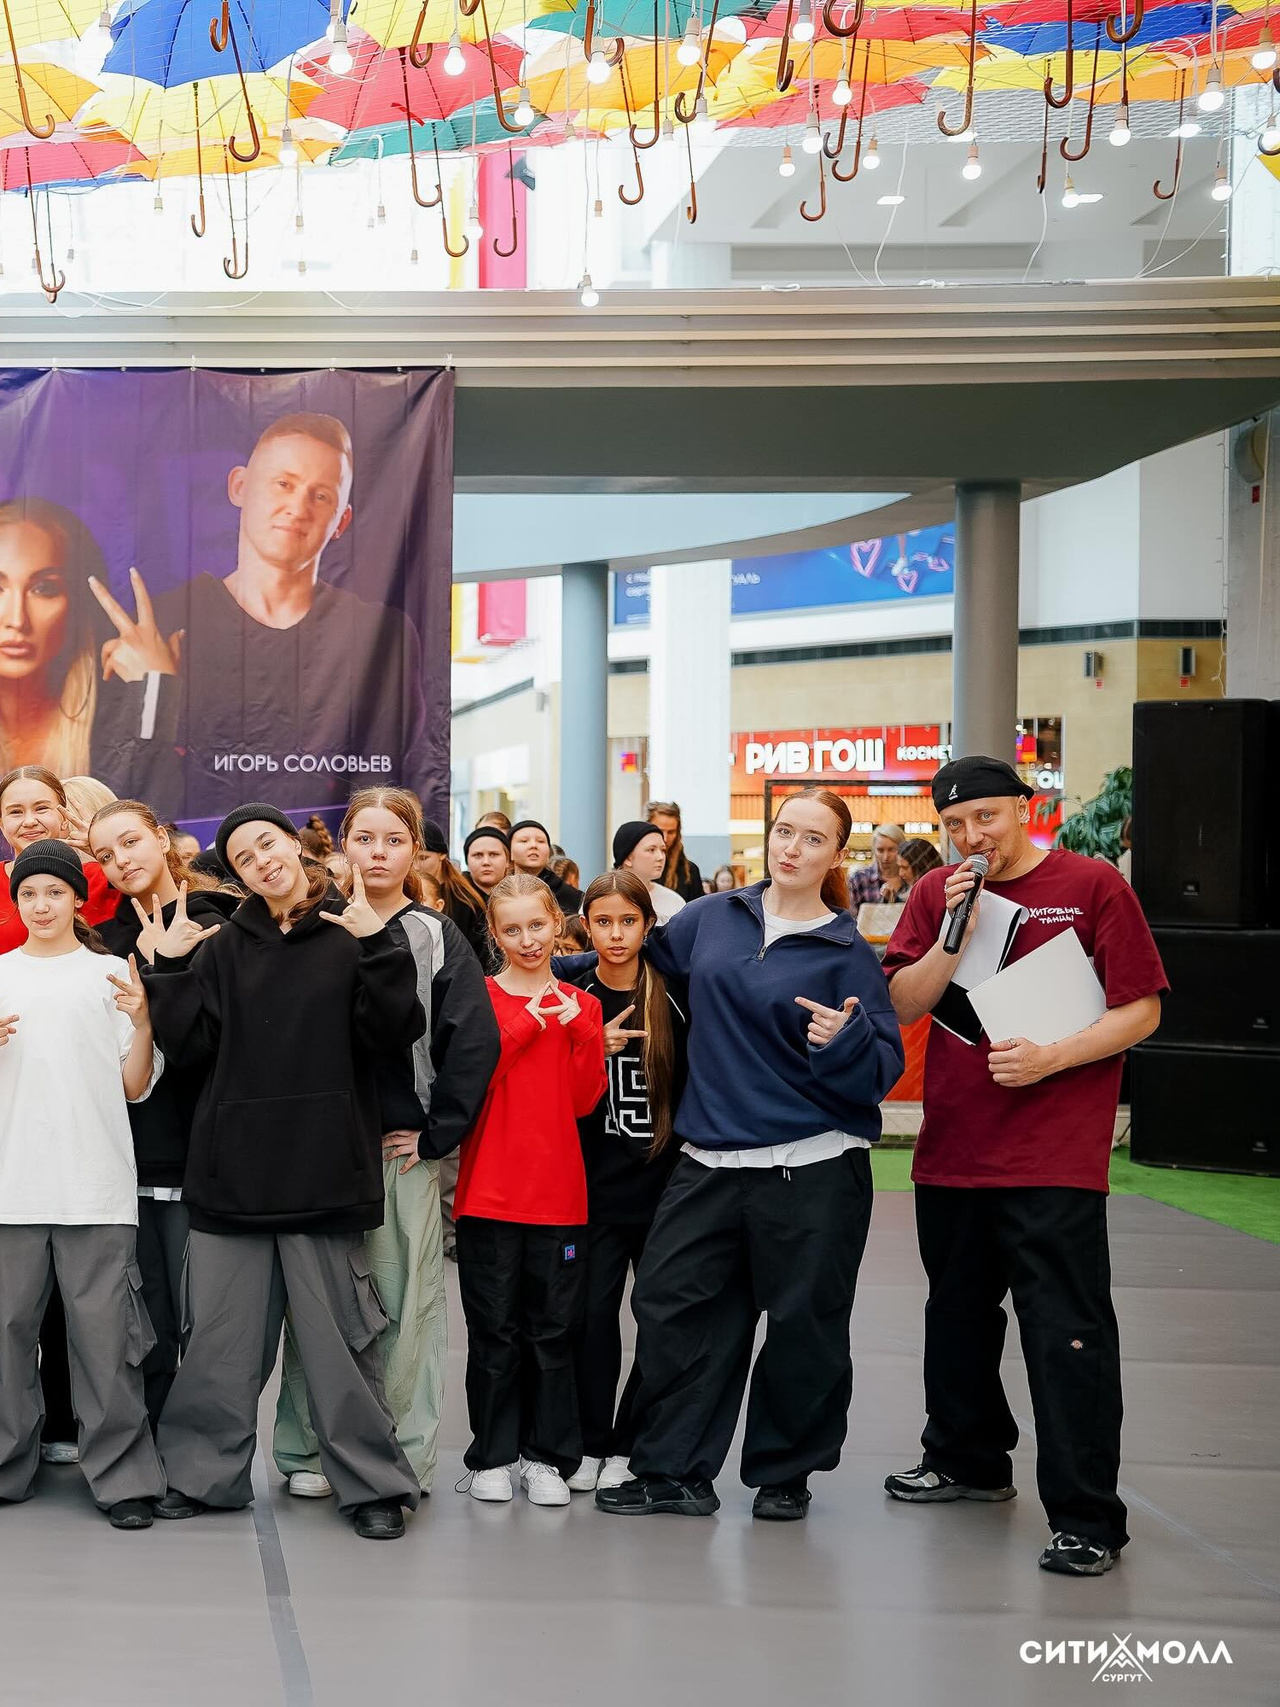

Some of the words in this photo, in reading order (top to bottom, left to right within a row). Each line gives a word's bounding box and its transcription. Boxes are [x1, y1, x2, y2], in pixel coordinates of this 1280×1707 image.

[213, 753, 279, 773] ИГОРЬ
[282, 753, 393, 773] СОЛОВЬЕВ
[745, 741, 811, 775] РИВ
[813, 737, 885, 774] ГОШ
[1029, 906, 1085, 919] ХИТОВЫЕ
[1038, 914, 1075, 925] ТАНЦЫ
